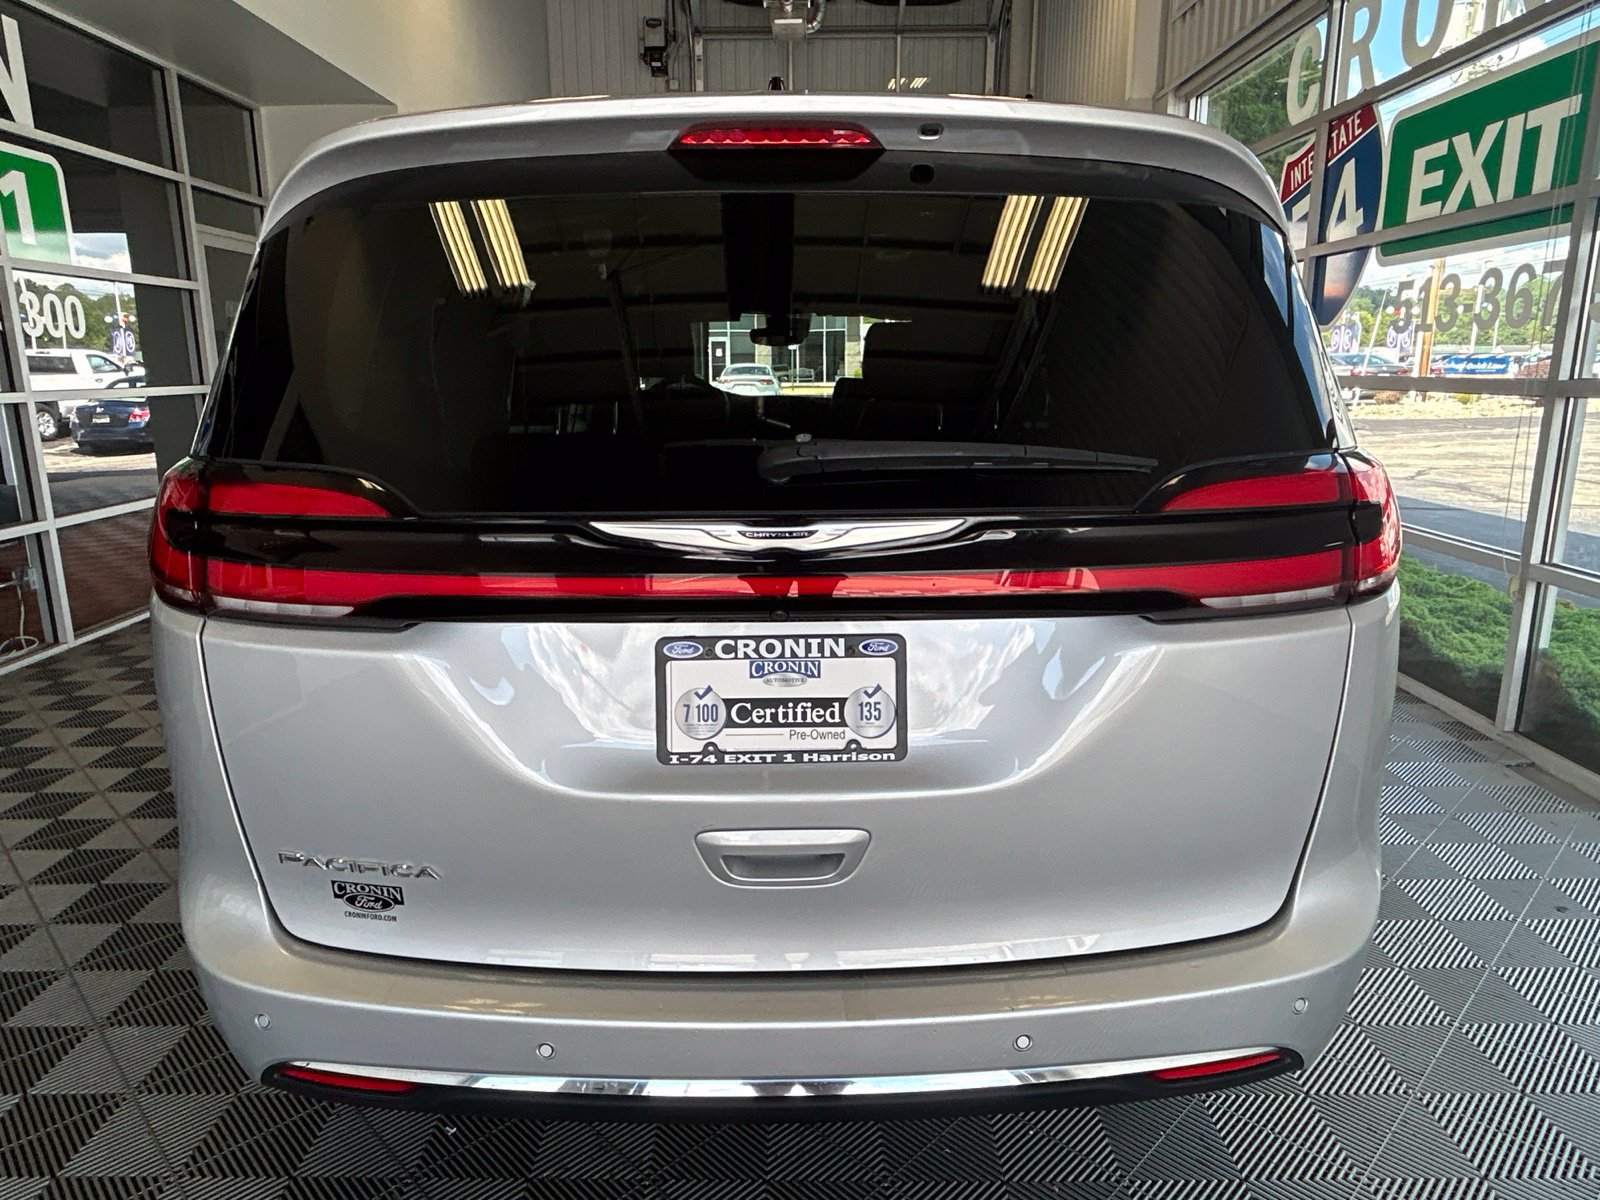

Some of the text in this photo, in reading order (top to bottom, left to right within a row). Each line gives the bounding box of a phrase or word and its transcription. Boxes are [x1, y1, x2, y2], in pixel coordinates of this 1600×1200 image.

[1290, 110, 1363, 191] INTETATE
[1406, 94, 1582, 223] EXIT
[0, 170, 36, 245] 1
[19, 291, 86, 339] 300
[715, 638, 845, 659] CRONIN
[752, 661, 819, 677] CRONIN
[683, 704, 718, 722] 7 100
[731, 702, 841, 724] Certified
[858, 702, 881, 721] 135
[789, 729, 846, 740] Pre-Owned
[669, 752, 895, 765] I-74 EXIT 1 Harrison
[278, 851, 442, 880] PACIFICA
[333, 882, 402, 901] CRONIN
[354, 895, 383, 910] Ford
[344, 911, 398, 922] CRONINFORD.COM
